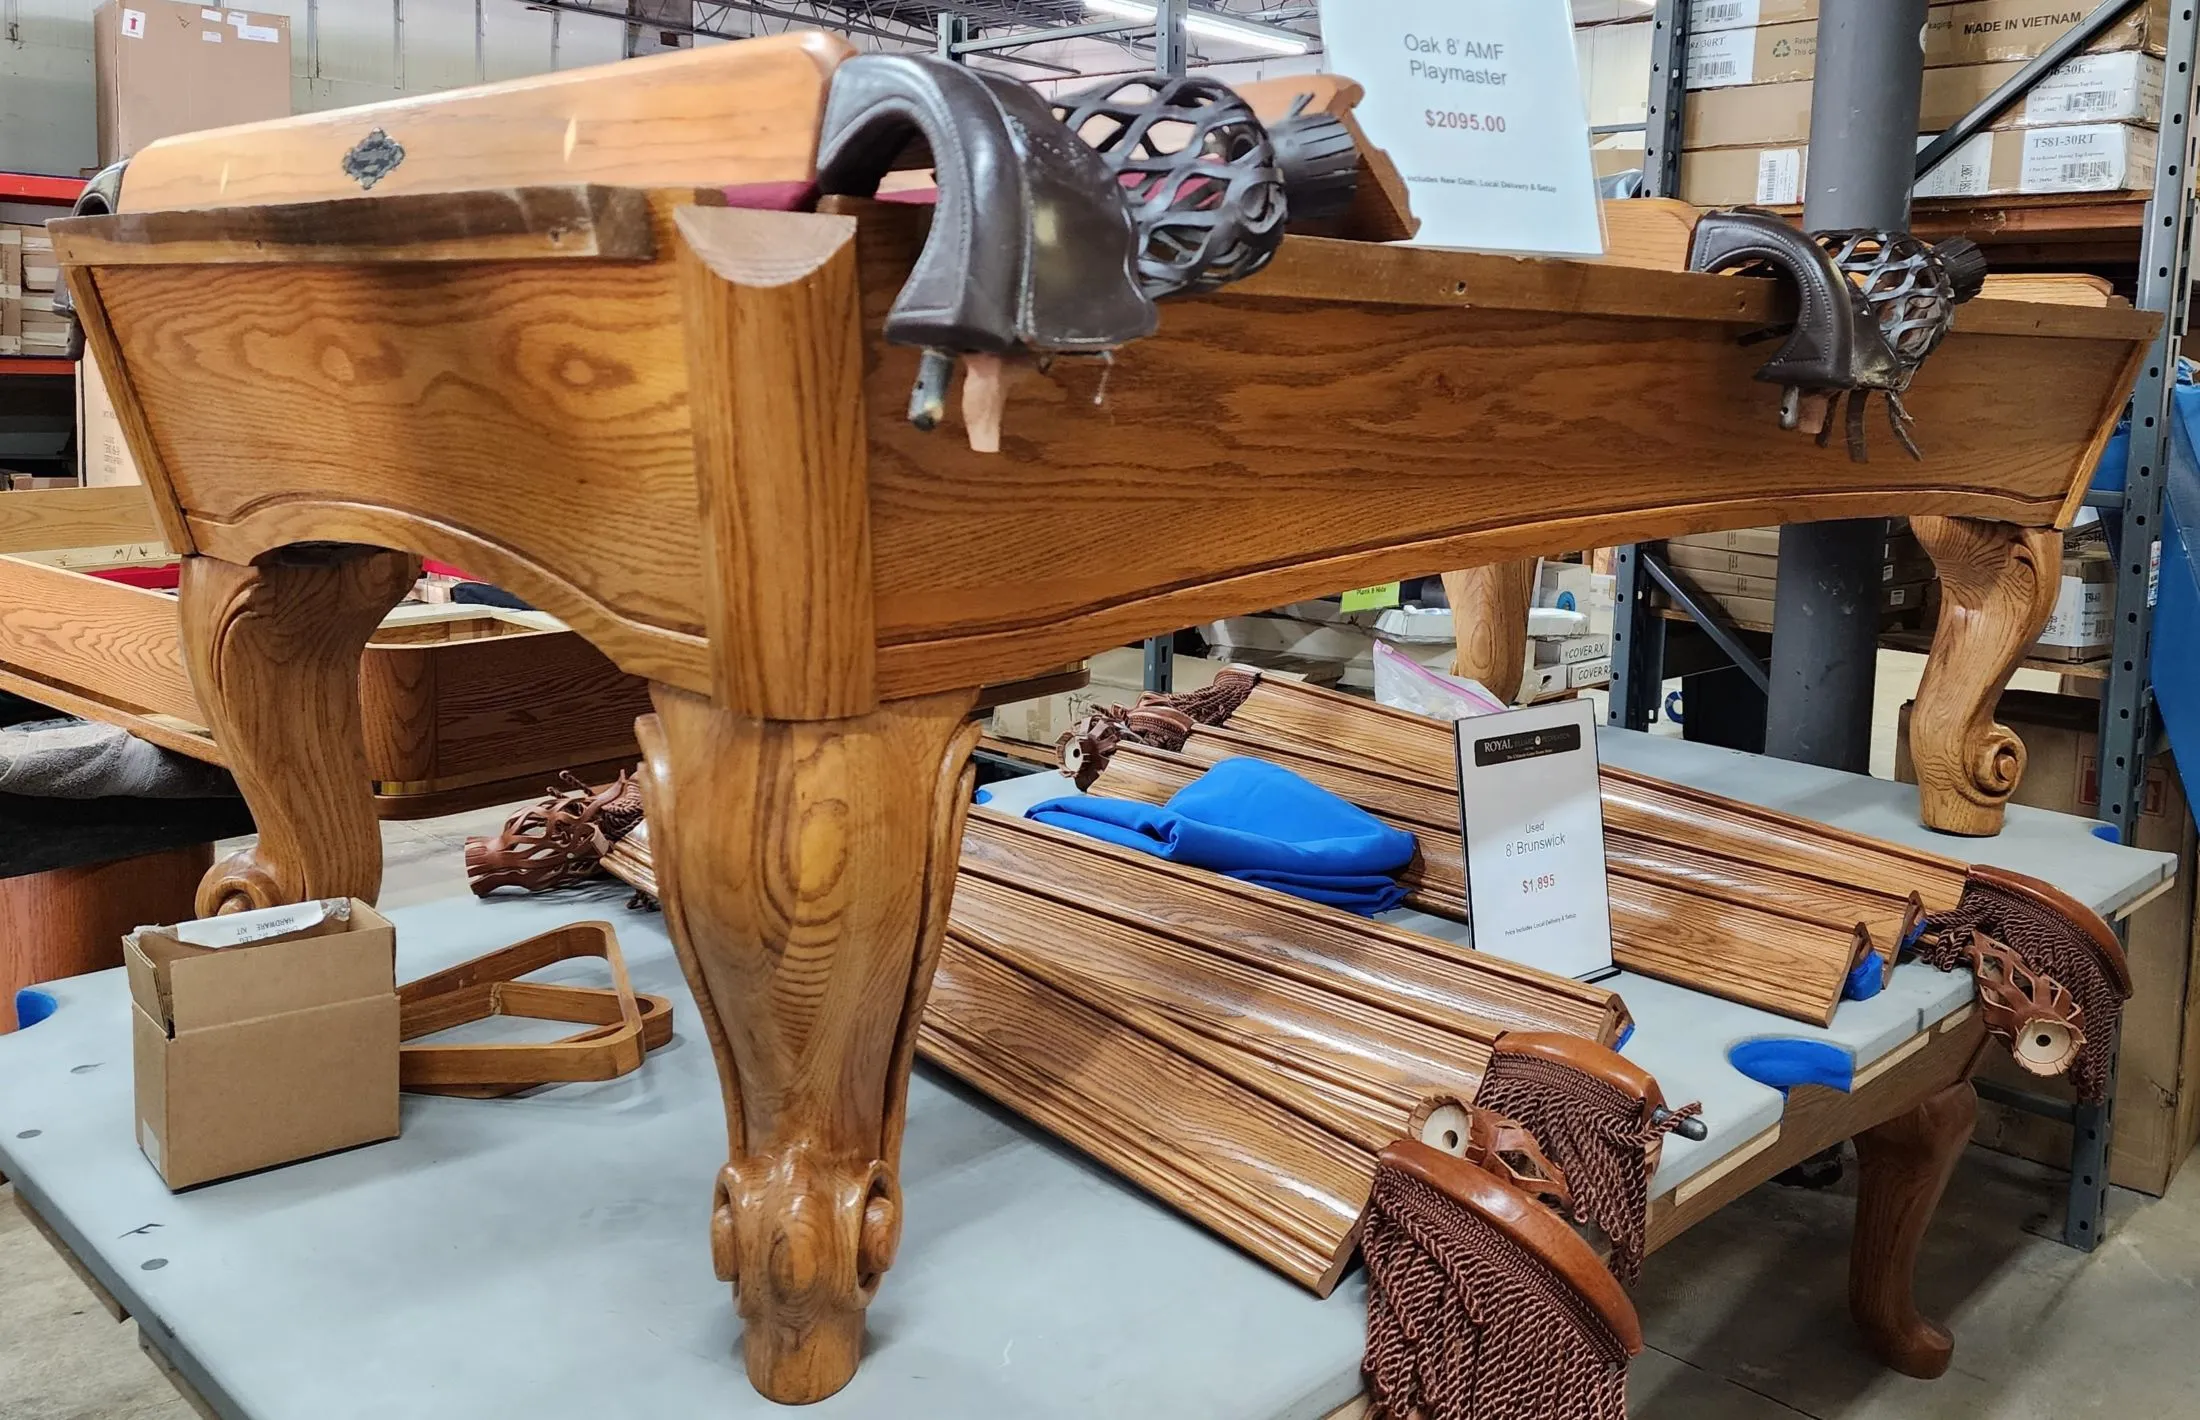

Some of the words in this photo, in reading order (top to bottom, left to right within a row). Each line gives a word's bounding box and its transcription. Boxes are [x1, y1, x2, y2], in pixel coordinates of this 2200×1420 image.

[1963, 21, 2001, 35] MADE
[2005, 19, 2019, 31] IN
[2021, 11, 2083, 29] VIETNAM
[1404, 33, 1441, 55] Oak
[1446, 38, 1460, 56] 8'
[1465, 41, 1505, 60] AMF
[1409, 60, 1507, 86] Playmaster
[1425, 109, 1507, 133] $2095.00
[2033, 133, 2097, 149] T581-30RT
[1440, 176, 1456, 184] New
[1479, 179, 1499, 188] Local
[1501, 181, 1529, 191] Delivery
[1537, 184, 1557, 193] Setup
[1569, 645, 1593, 659] COVER
[1594, 642, 1605, 653] RX
[1578, 666, 1603, 681] COVER
[1484, 740, 1513, 753] ROYAL
[1525, 820, 1545, 834] Used
[1505, 841, 1514, 858] 8'
[1516, 833, 1566, 856] Brunswick
[1522, 874, 1555, 895] $1,895
[255, 917, 294, 930] HARDWARE
[1505, 929, 1516, 937] Price
[1533, 920, 1545, 929] Local
[1546, 917, 1561, 926] Delivery
